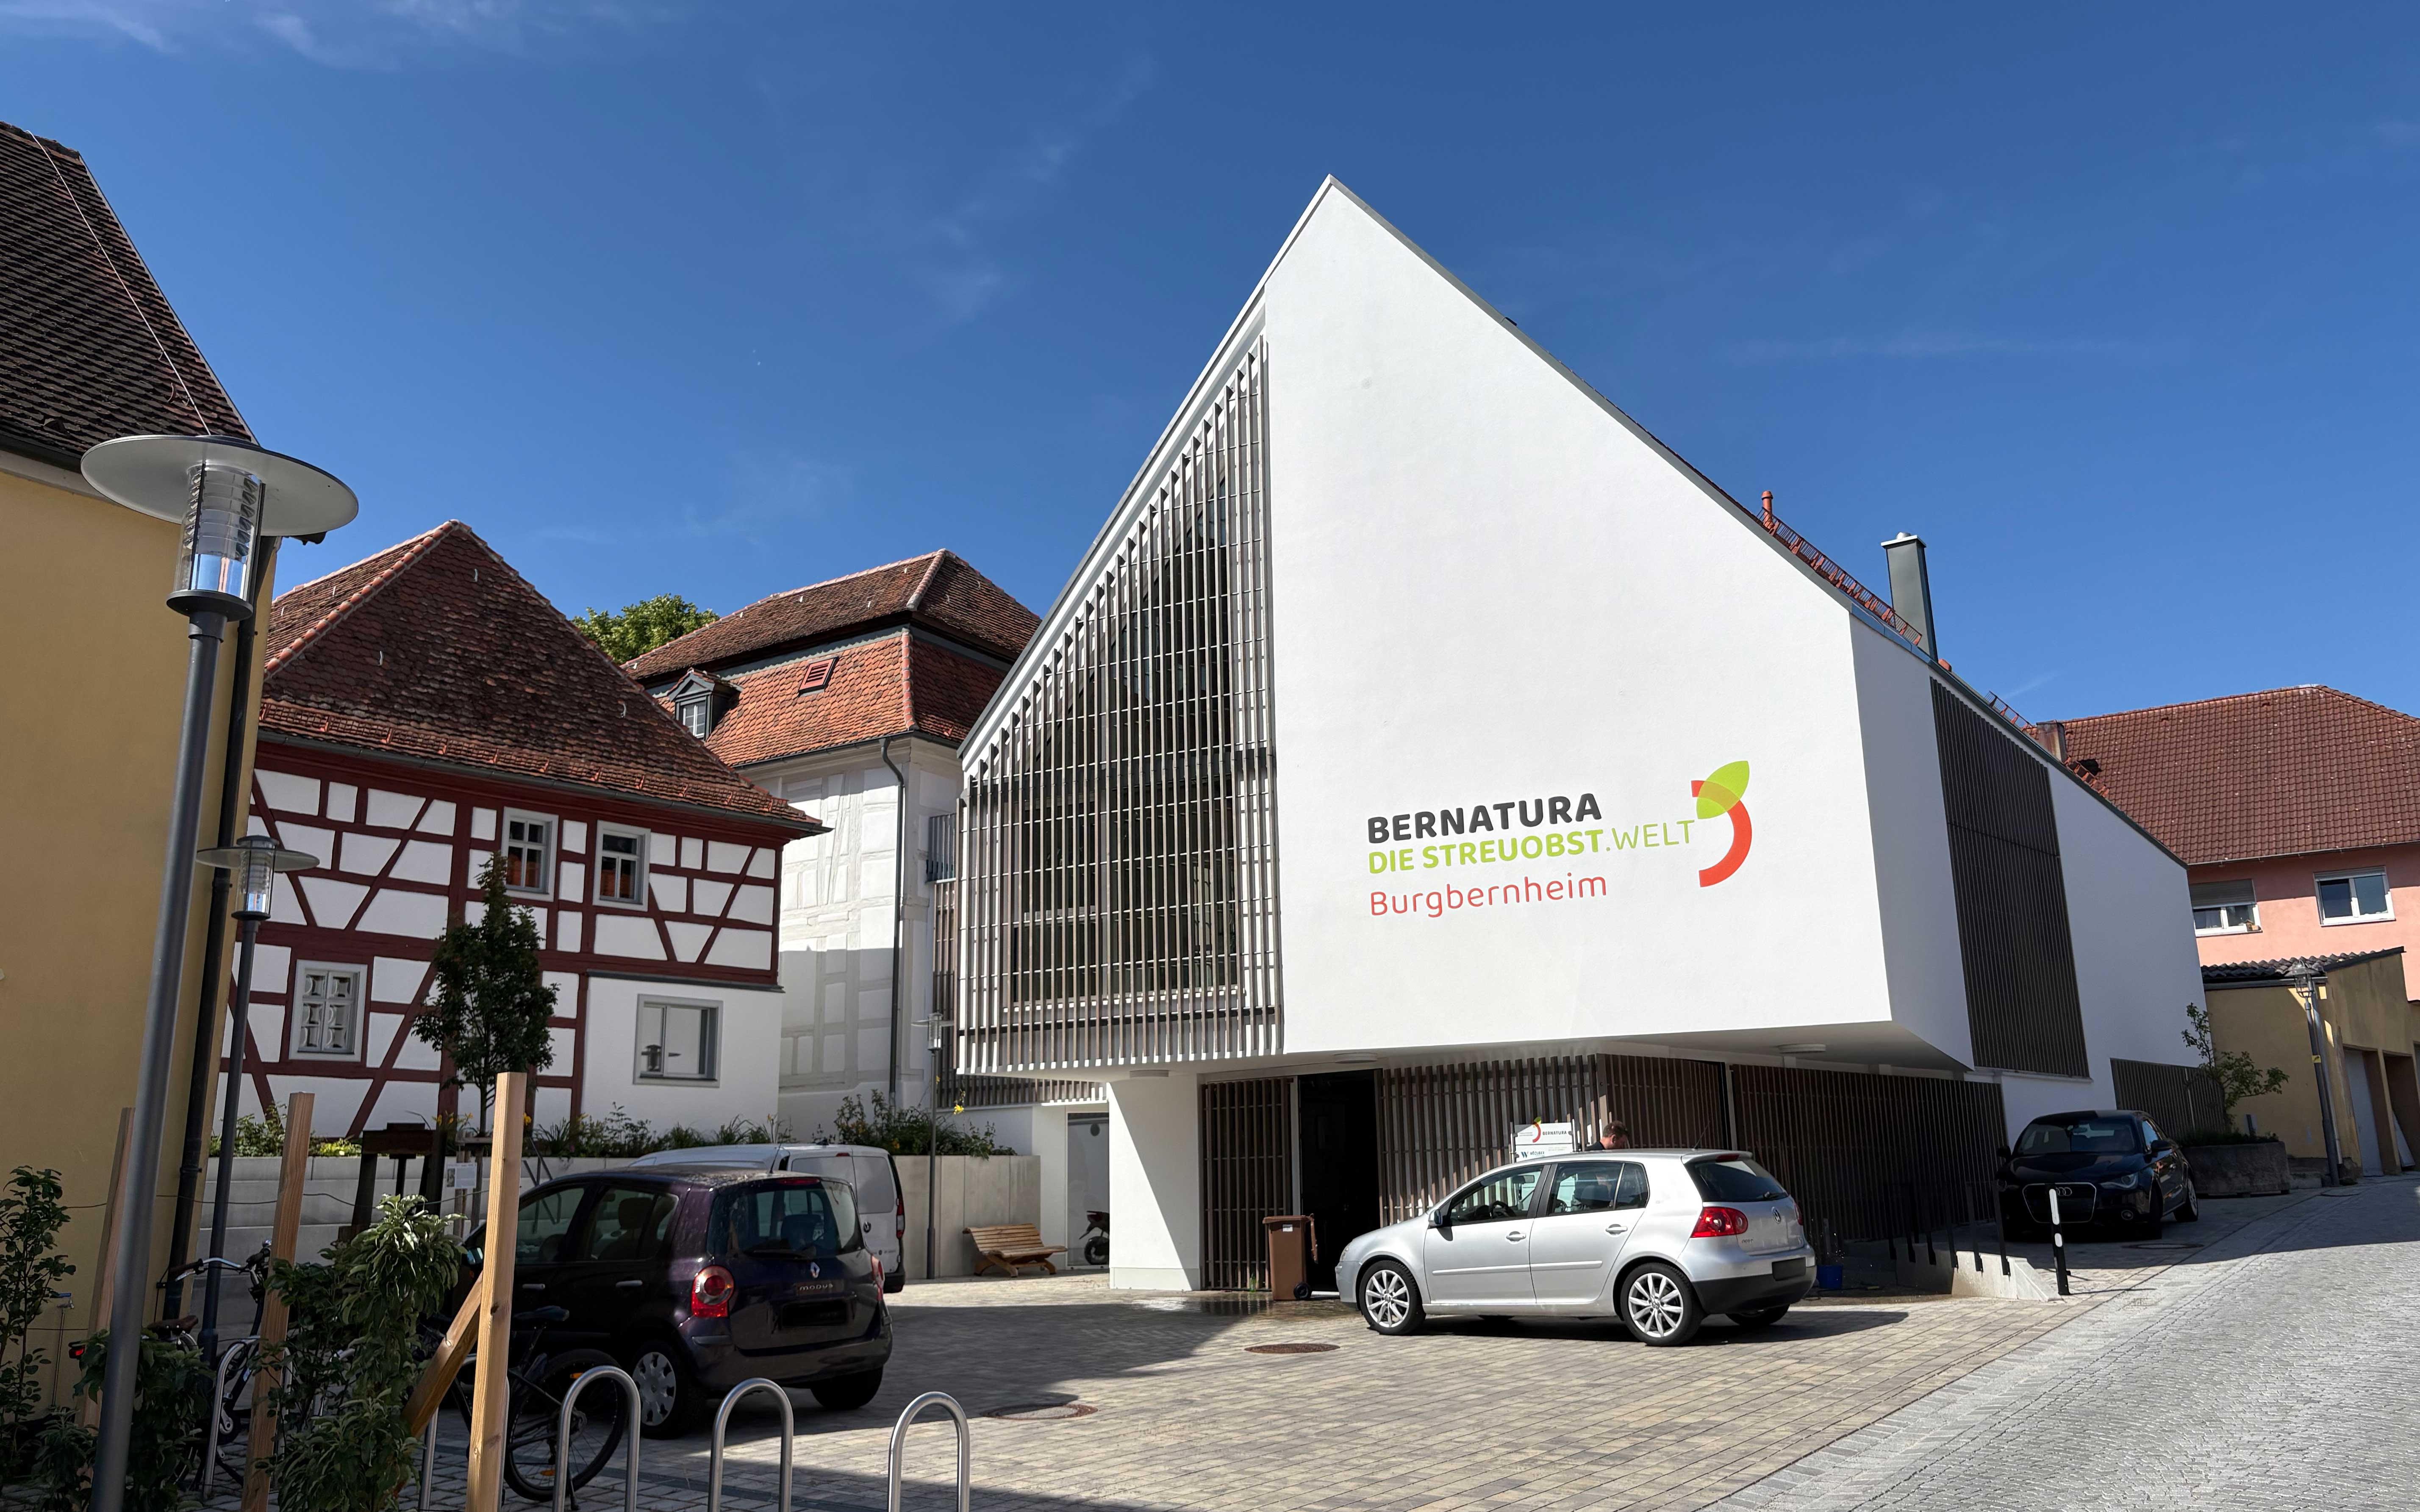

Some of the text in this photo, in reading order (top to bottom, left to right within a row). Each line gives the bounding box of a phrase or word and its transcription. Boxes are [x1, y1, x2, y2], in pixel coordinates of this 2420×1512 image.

[1368, 793, 1602, 844] BERNATURA
[1369, 820, 1694, 875] DIE STREUOBST.WELT
[1371, 872, 1607, 918] Burgbernheim
